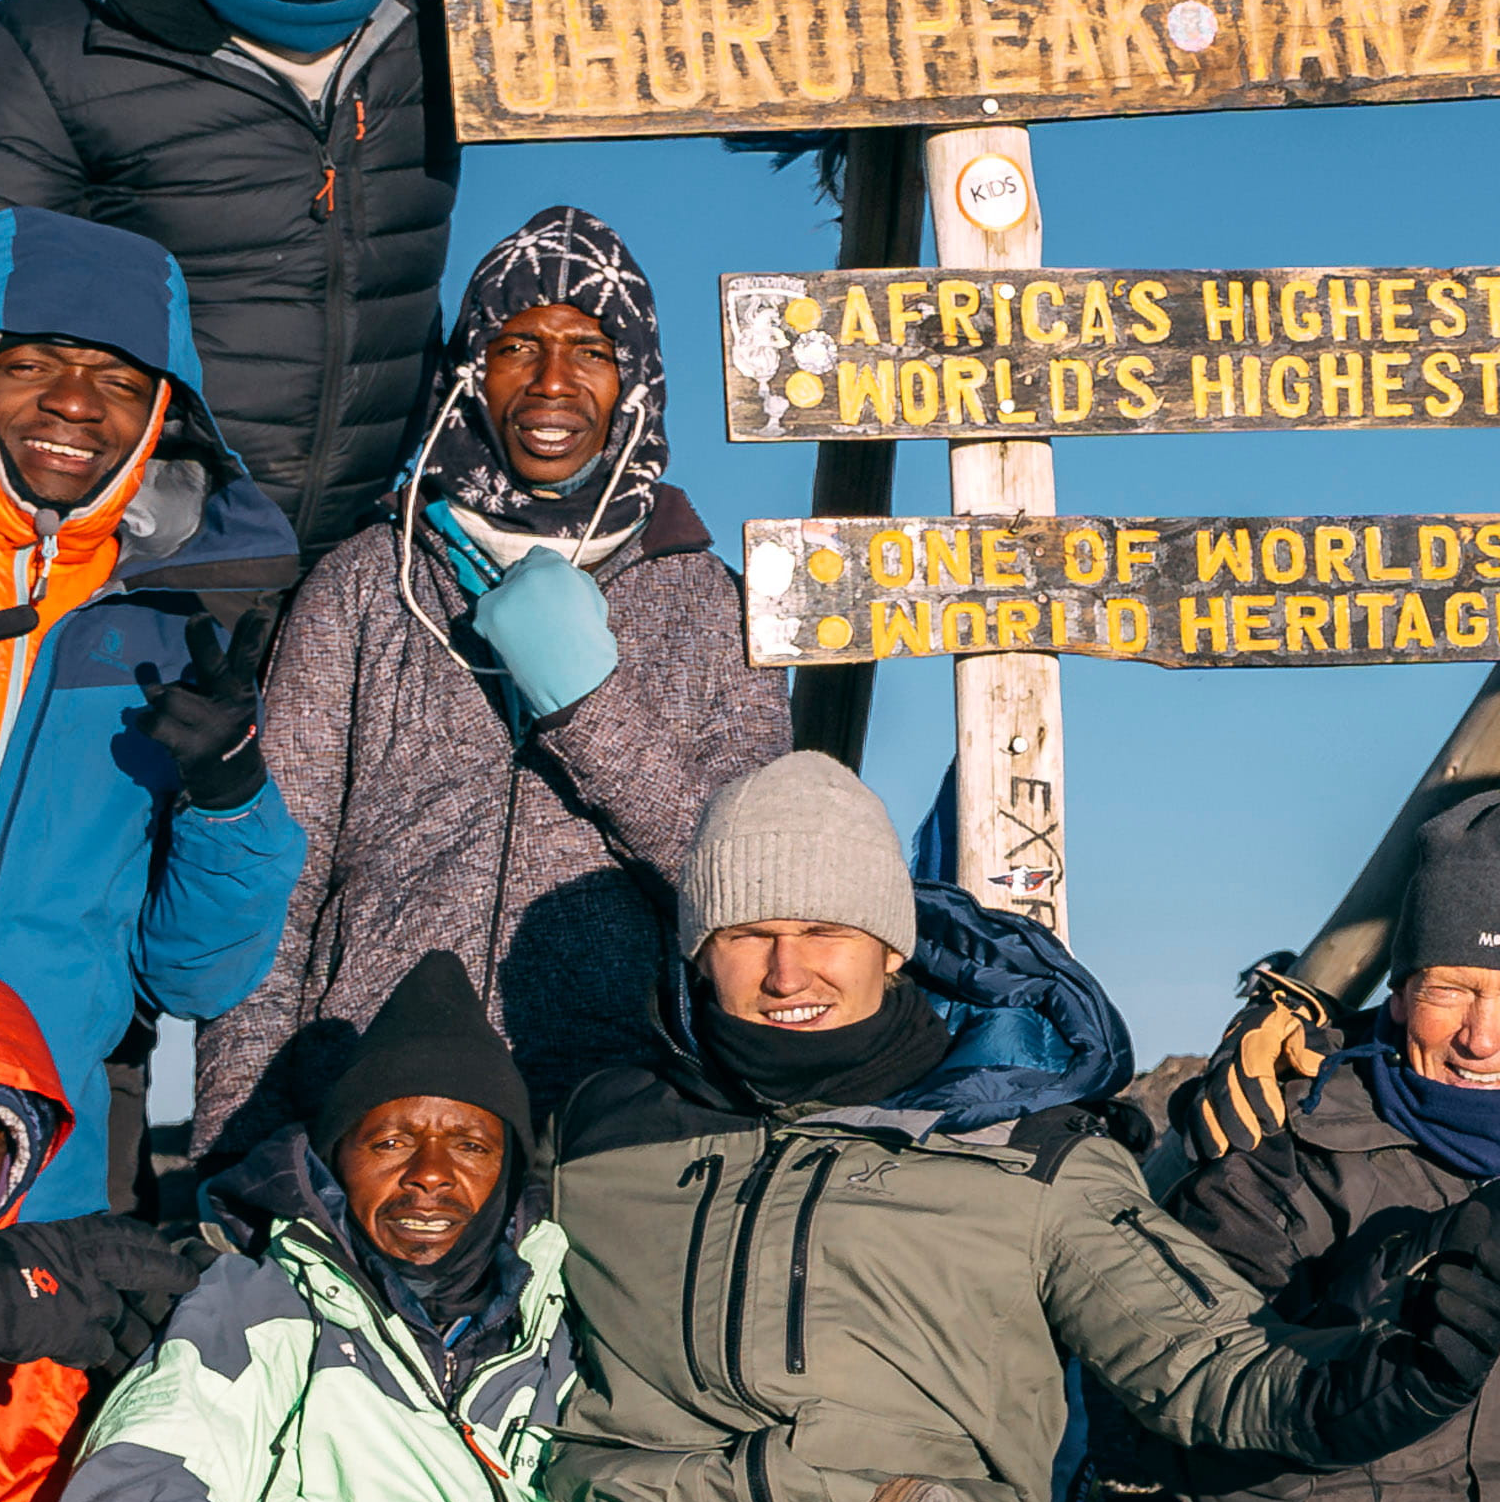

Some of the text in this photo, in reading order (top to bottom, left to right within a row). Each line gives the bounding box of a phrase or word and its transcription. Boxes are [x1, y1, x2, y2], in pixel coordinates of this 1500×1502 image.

[971, 175, 1018, 204] KIDS
[840, 279, 1171, 347] AFRICA'S
[838, 356, 1165, 426] WORLD'S
[870, 528, 1027, 588] ONE
[1065, 528, 1160, 585] OF
